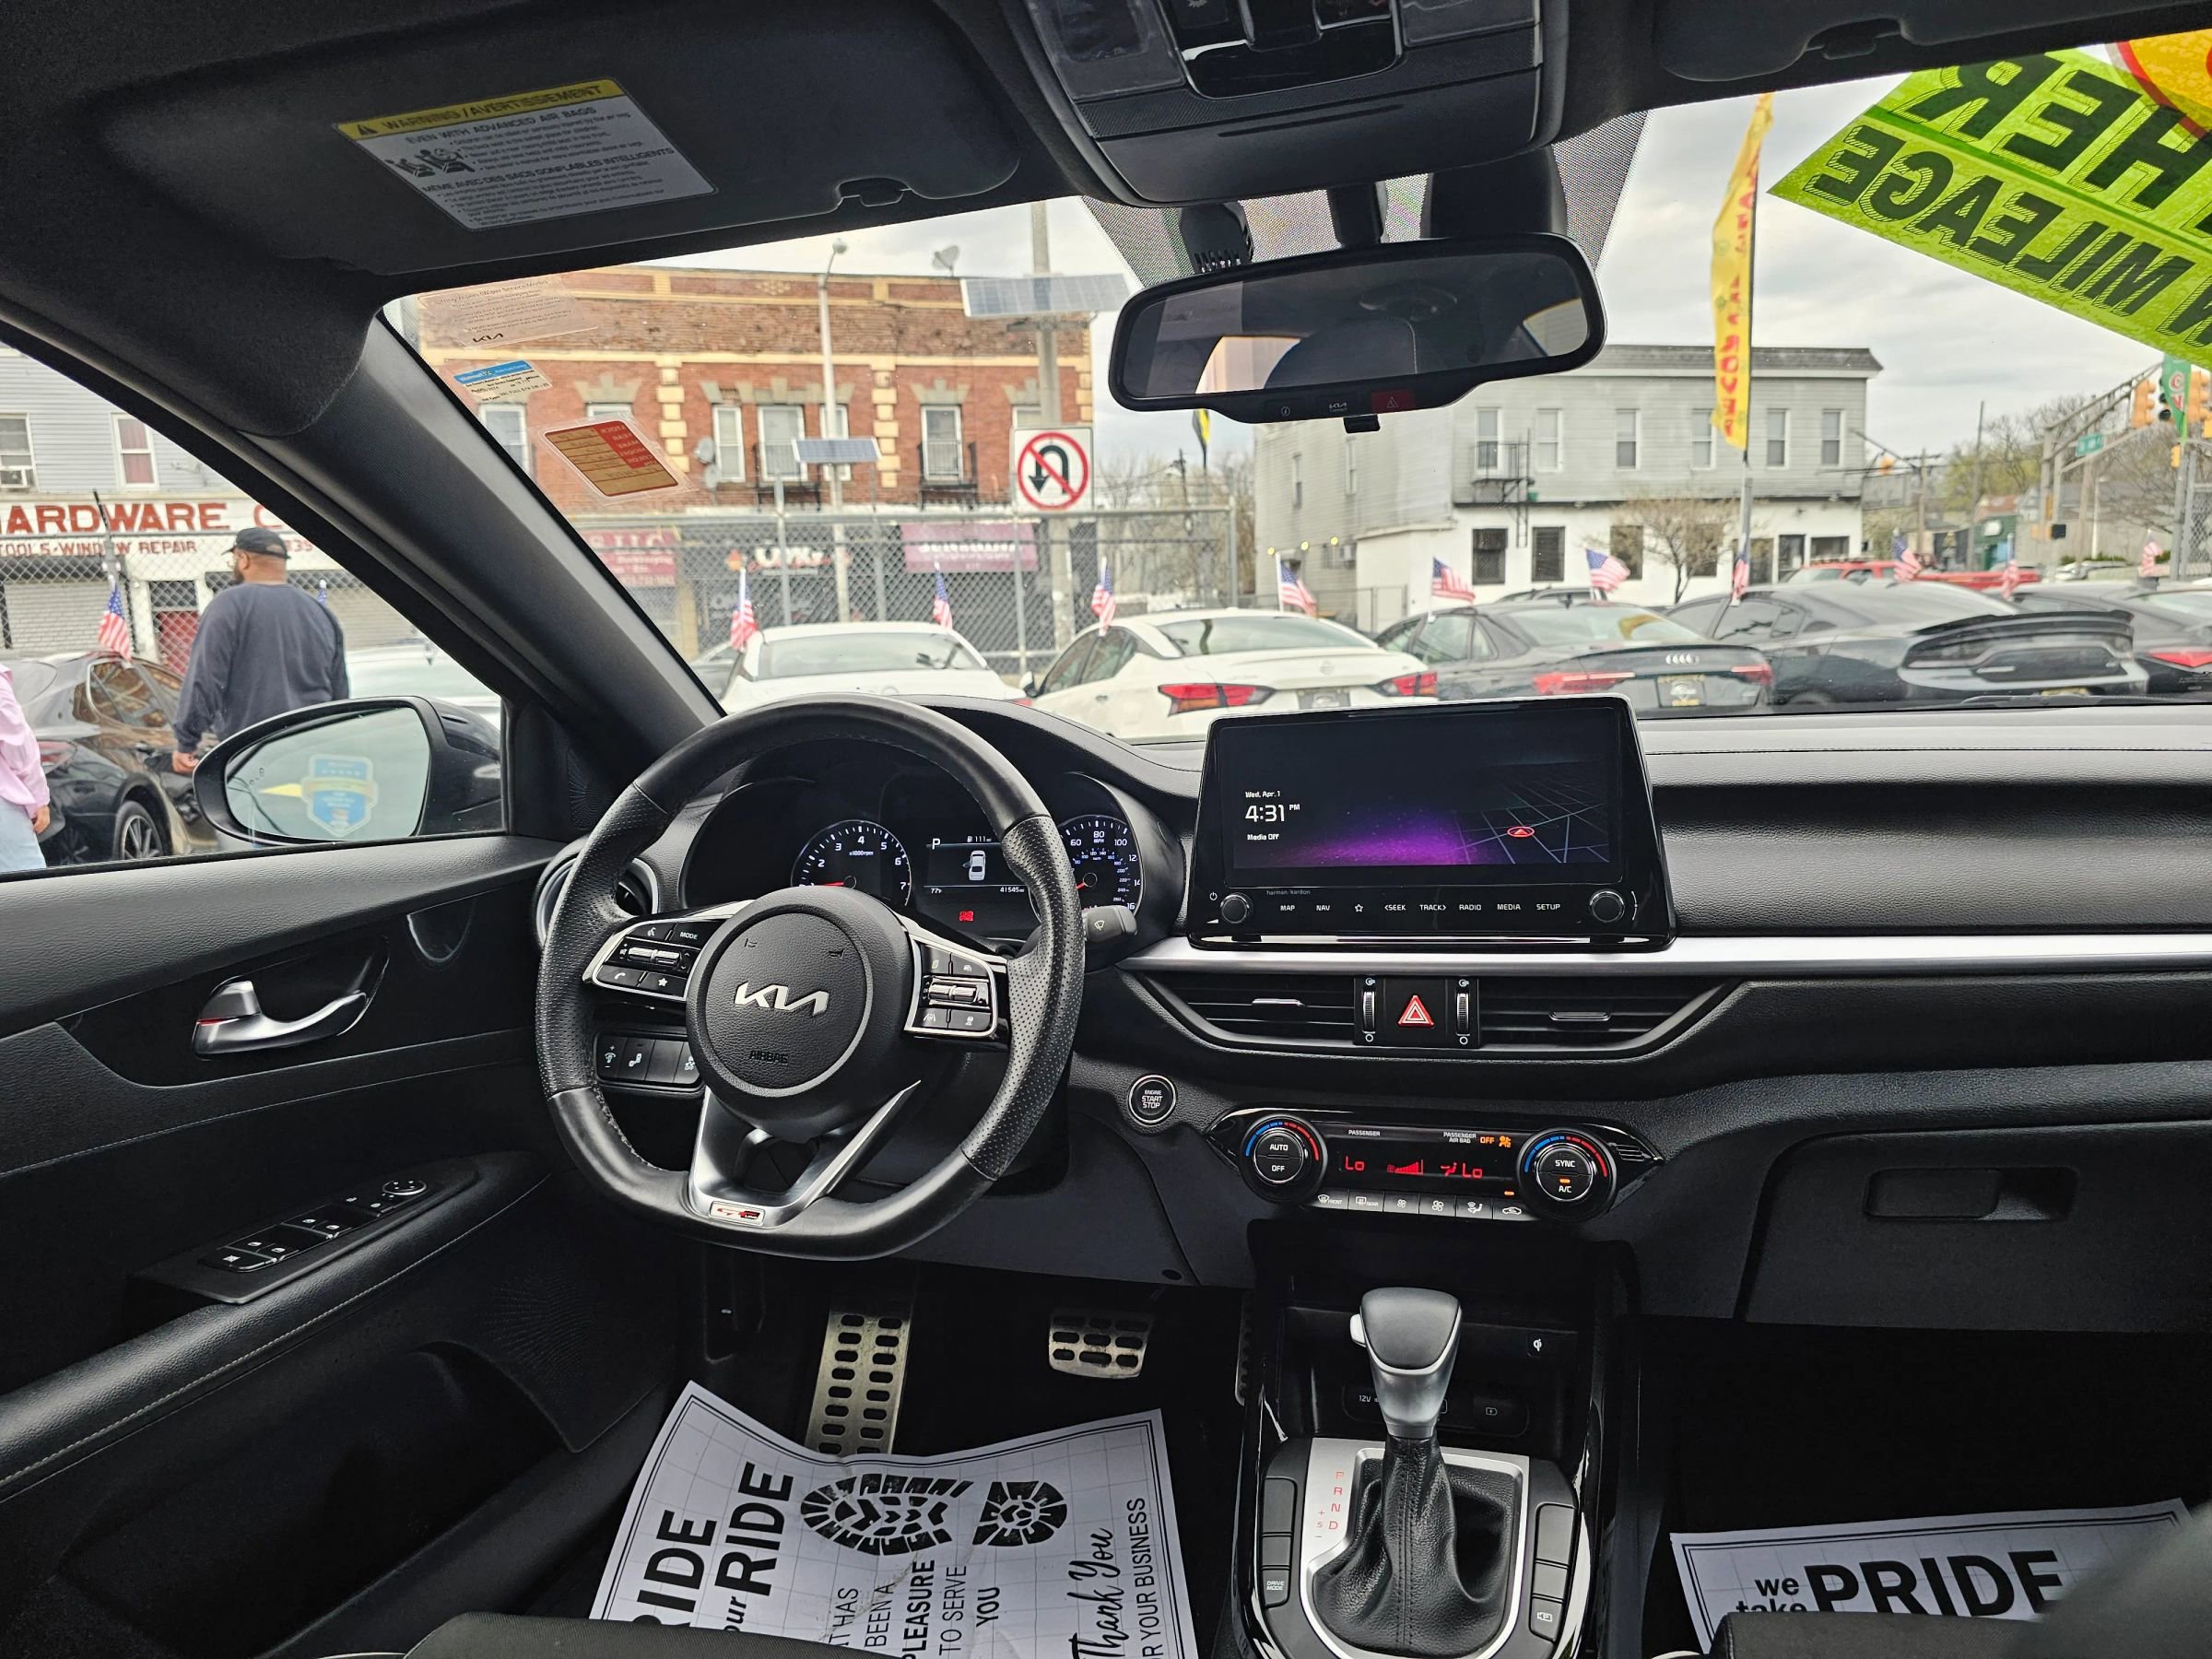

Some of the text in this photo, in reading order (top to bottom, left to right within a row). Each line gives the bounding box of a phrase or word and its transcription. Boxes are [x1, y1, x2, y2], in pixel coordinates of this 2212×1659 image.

[382, 110, 460, 131] WARNING
[406, 106, 598, 145] EVEN WITH ADVANCED AIR BAGS
[0, 502, 230, 535] ARDWARE
[139, 540, 197, 555] REPAIR
[1244, 804, 1285, 822] 4:31
[834, 841, 888, 851] 3 5
[857, 835, 865, 844] 4
[932, 838, 941, 850] P
[818, 857, 901, 867] 2 6
[900, 881, 907, 890] 7
[679, 931, 699, 940] MODE
[1345, 1156, 1365, 1171] Lo
[1462, 1162, 1483, 1179] Lo
[1555, 1159, 1576, 1168] SYNC
[1558, 1185, 1572, 1194] A/C
[1335, 1471, 1344, 1479] P
[1334, 1487, 1343, 1495] R
[1331, 1503, 1341, 1512] N
[714, 1461, 794, 1596] RIDE
[1328, 1521, 1338, 1530] D
[1126, 1497, 1155, 1587] BUSINESS
[633, 1509, 717, 1626] IDE
[1066, 1527, 1130, 1659] Thank You
[1755, 1577, 1799, 1596] we
[832, 1587, 859, 1628] HAS
[865, 1582, 896, 1647] BEEN A
[939, 1566, 967, 1655] TO SERVE
[976, 1586, 1000, 1628] YOU
[1135, 1591, 1161, 1641] YOUR
